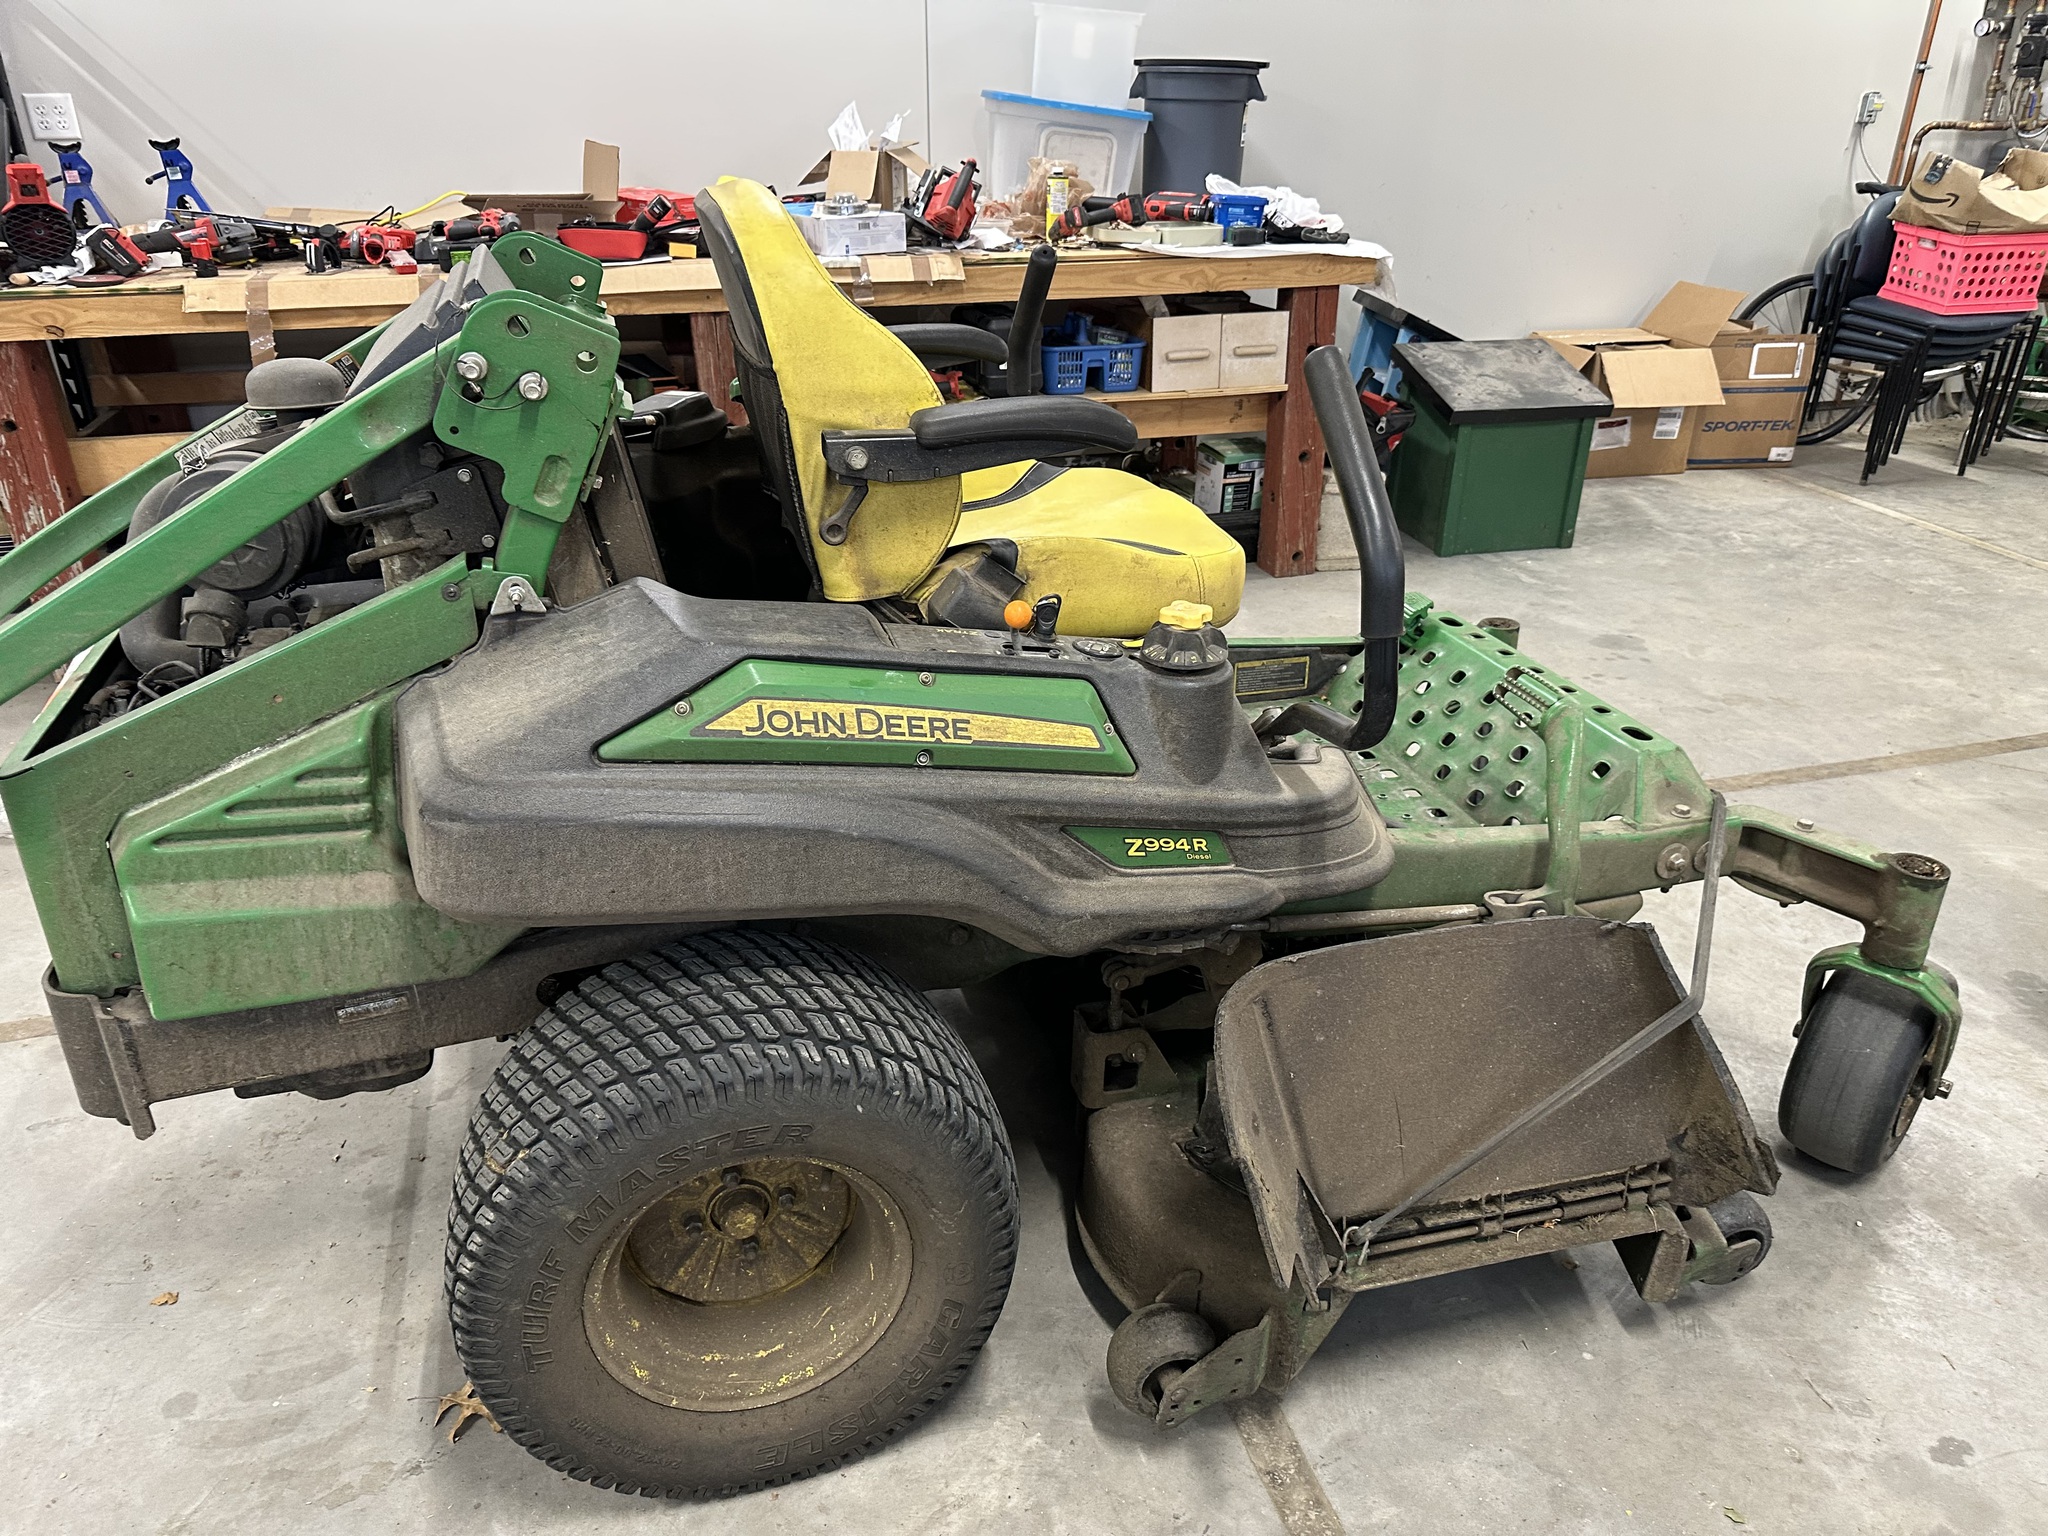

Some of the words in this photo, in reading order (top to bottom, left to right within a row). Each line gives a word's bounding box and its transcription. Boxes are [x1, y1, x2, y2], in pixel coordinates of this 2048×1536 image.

[1701, 419, 1794, 433] SPORT-TEK
[745, 704, 847, 736] JOHN
[855, 707, 973, 741] DEERE
[1124, 837, 1209, 857] Z994R
[521, 1247, 567, 1373] TURF
[563, 1124, 814, 1244] MASTER
[753, 1298, 966, 1471] CARLISLE
